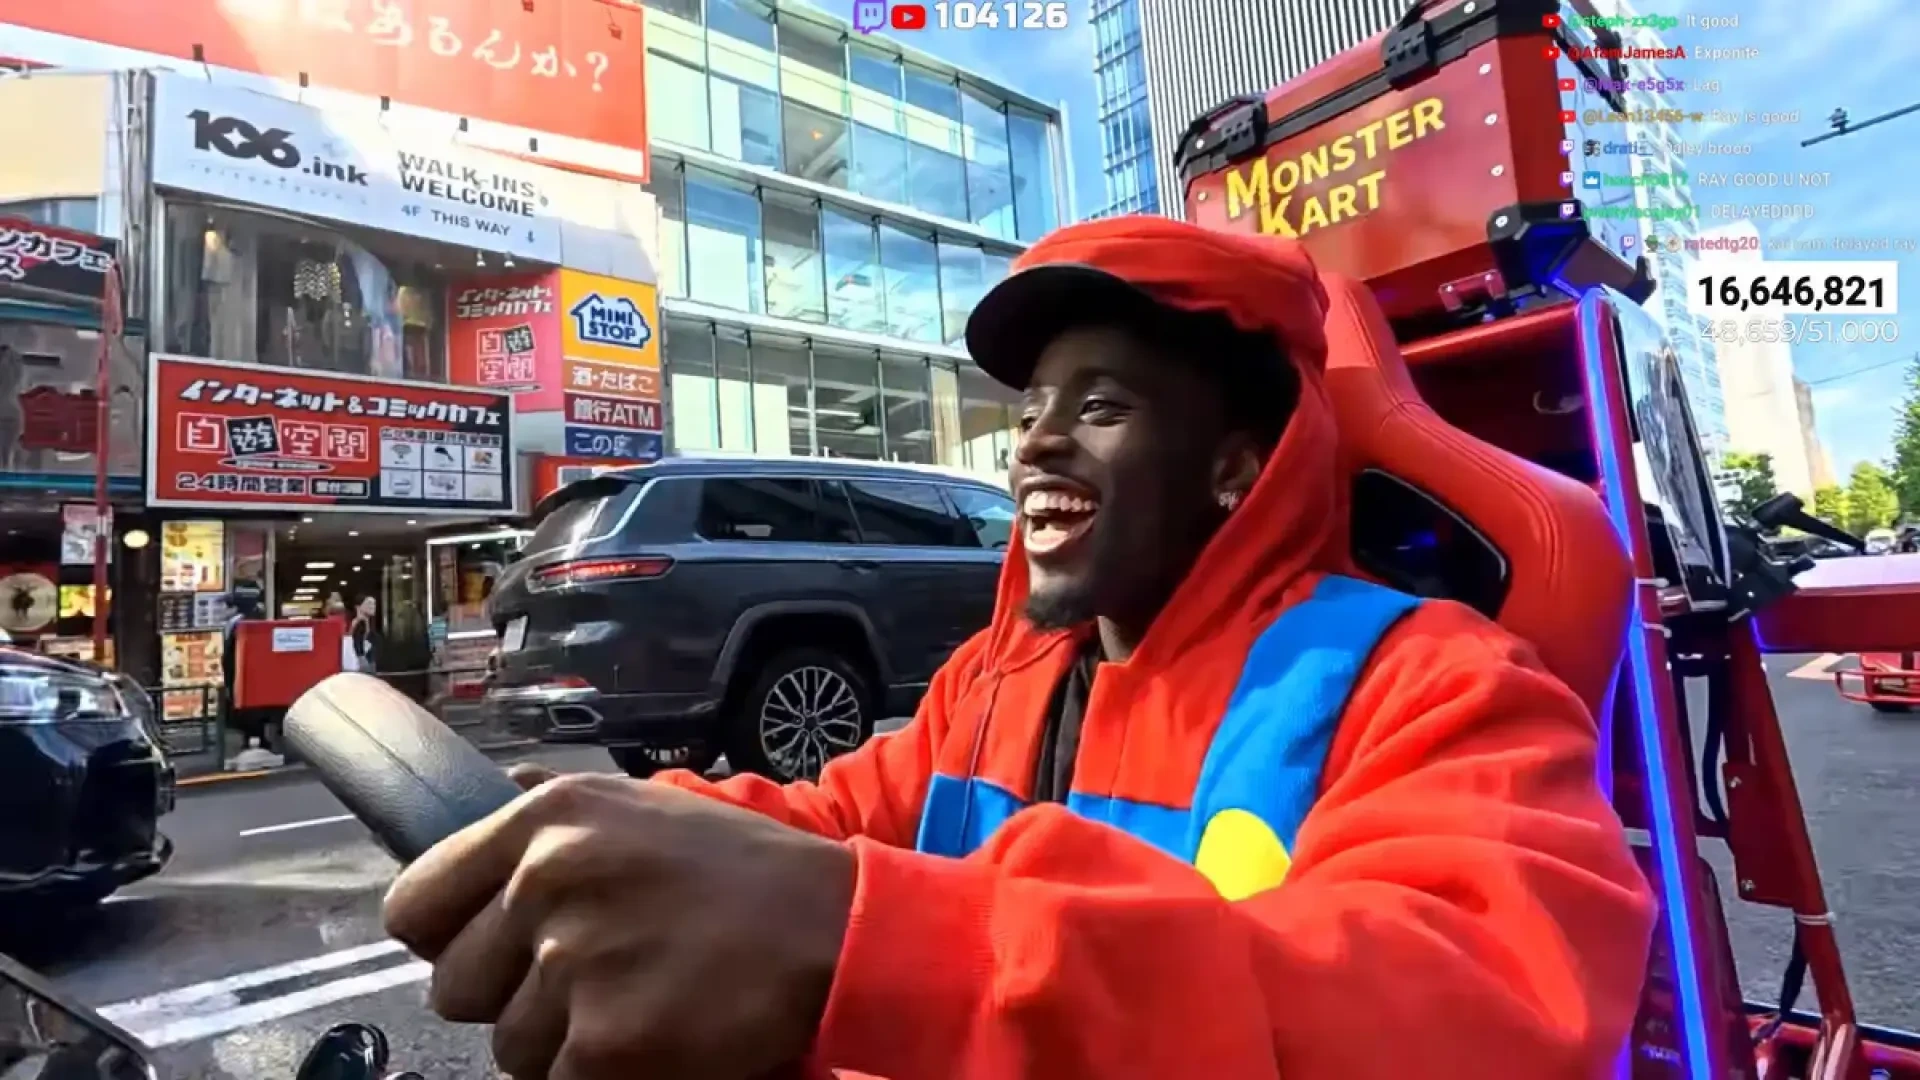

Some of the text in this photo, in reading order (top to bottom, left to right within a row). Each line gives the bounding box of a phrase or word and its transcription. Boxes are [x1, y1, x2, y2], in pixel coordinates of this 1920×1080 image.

[398, 150, 537, 199] WALK-INS
[1225, 97, 1446, 219] MONSTER
[400, 169, 535, 218] WELCOME
[1258, 170, 1386, 239] KART
[401, 204, 511, 236] 4F THIS WAY
[588, 322, 637, 341] STOP
[591, 305, 635, 326] MINI
